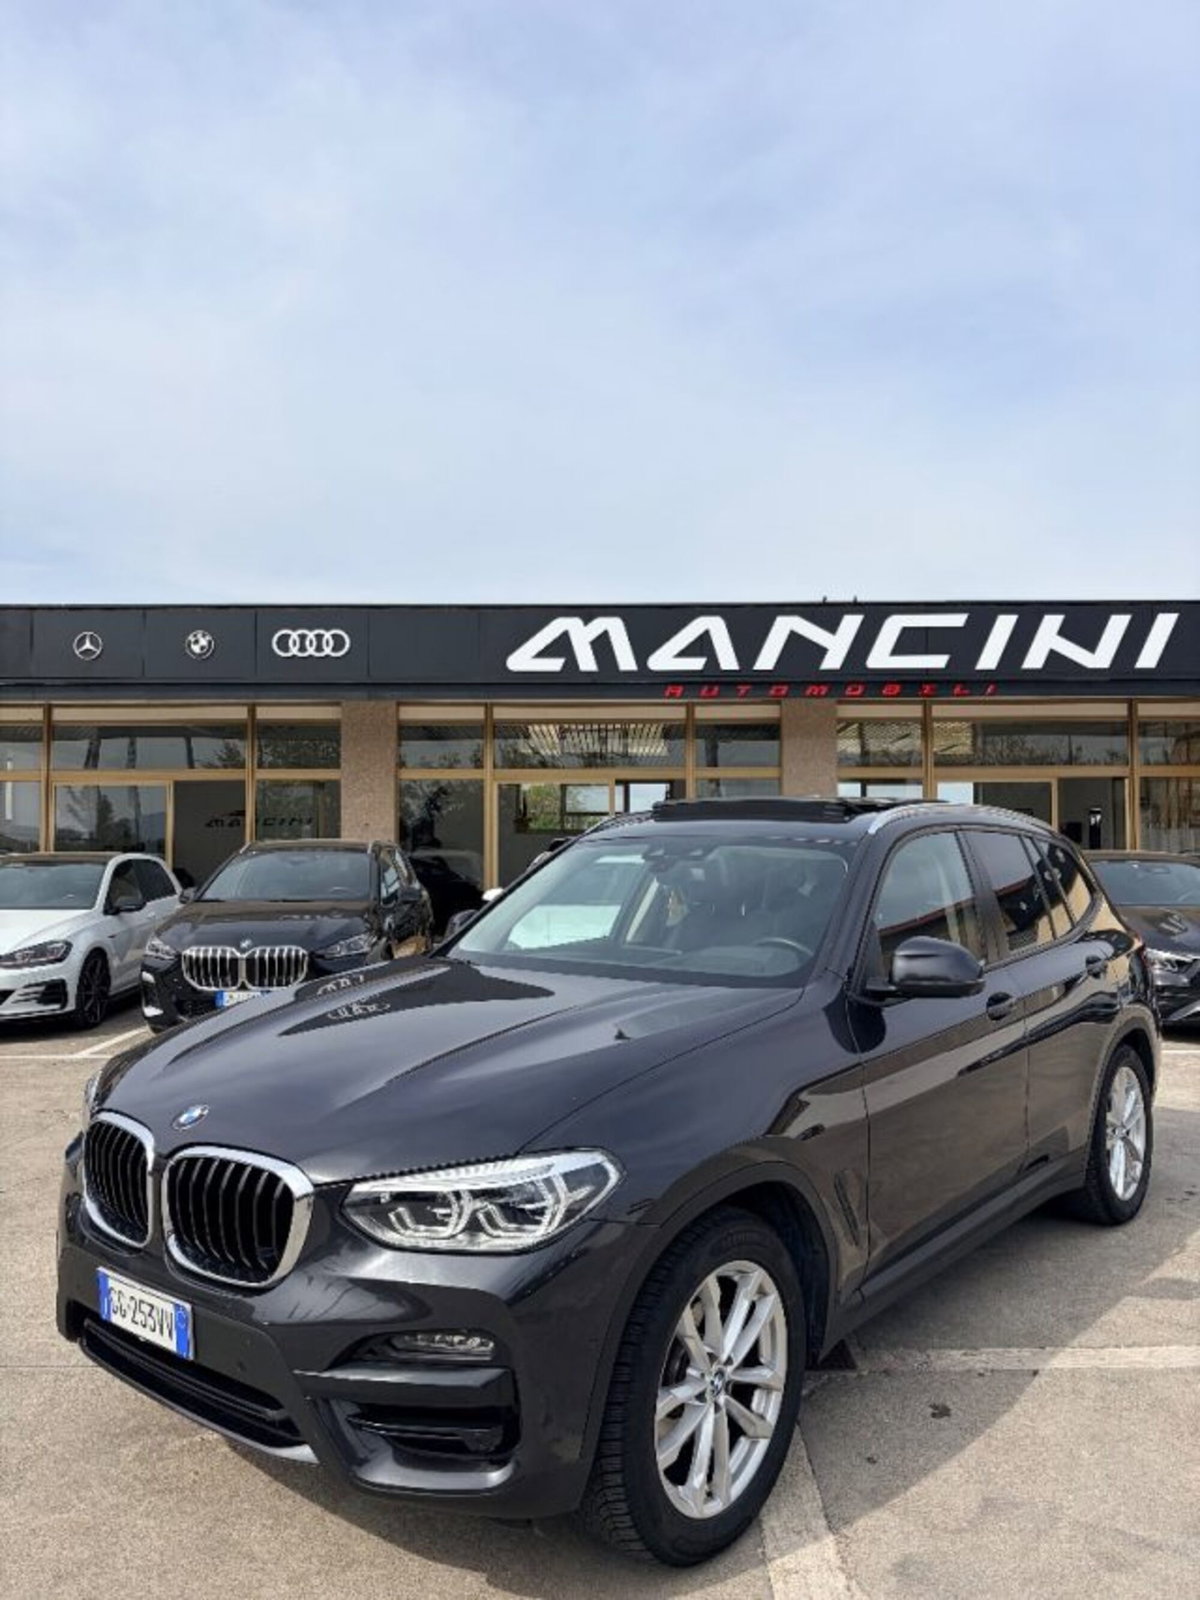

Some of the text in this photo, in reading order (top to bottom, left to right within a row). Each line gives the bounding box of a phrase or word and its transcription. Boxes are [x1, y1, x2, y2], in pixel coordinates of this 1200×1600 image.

[506, 612, 1179, 672] MANCINI
[664, 683, 997, 699] AUTOMOBILI
[204, 816, 314, 828] MACINI
